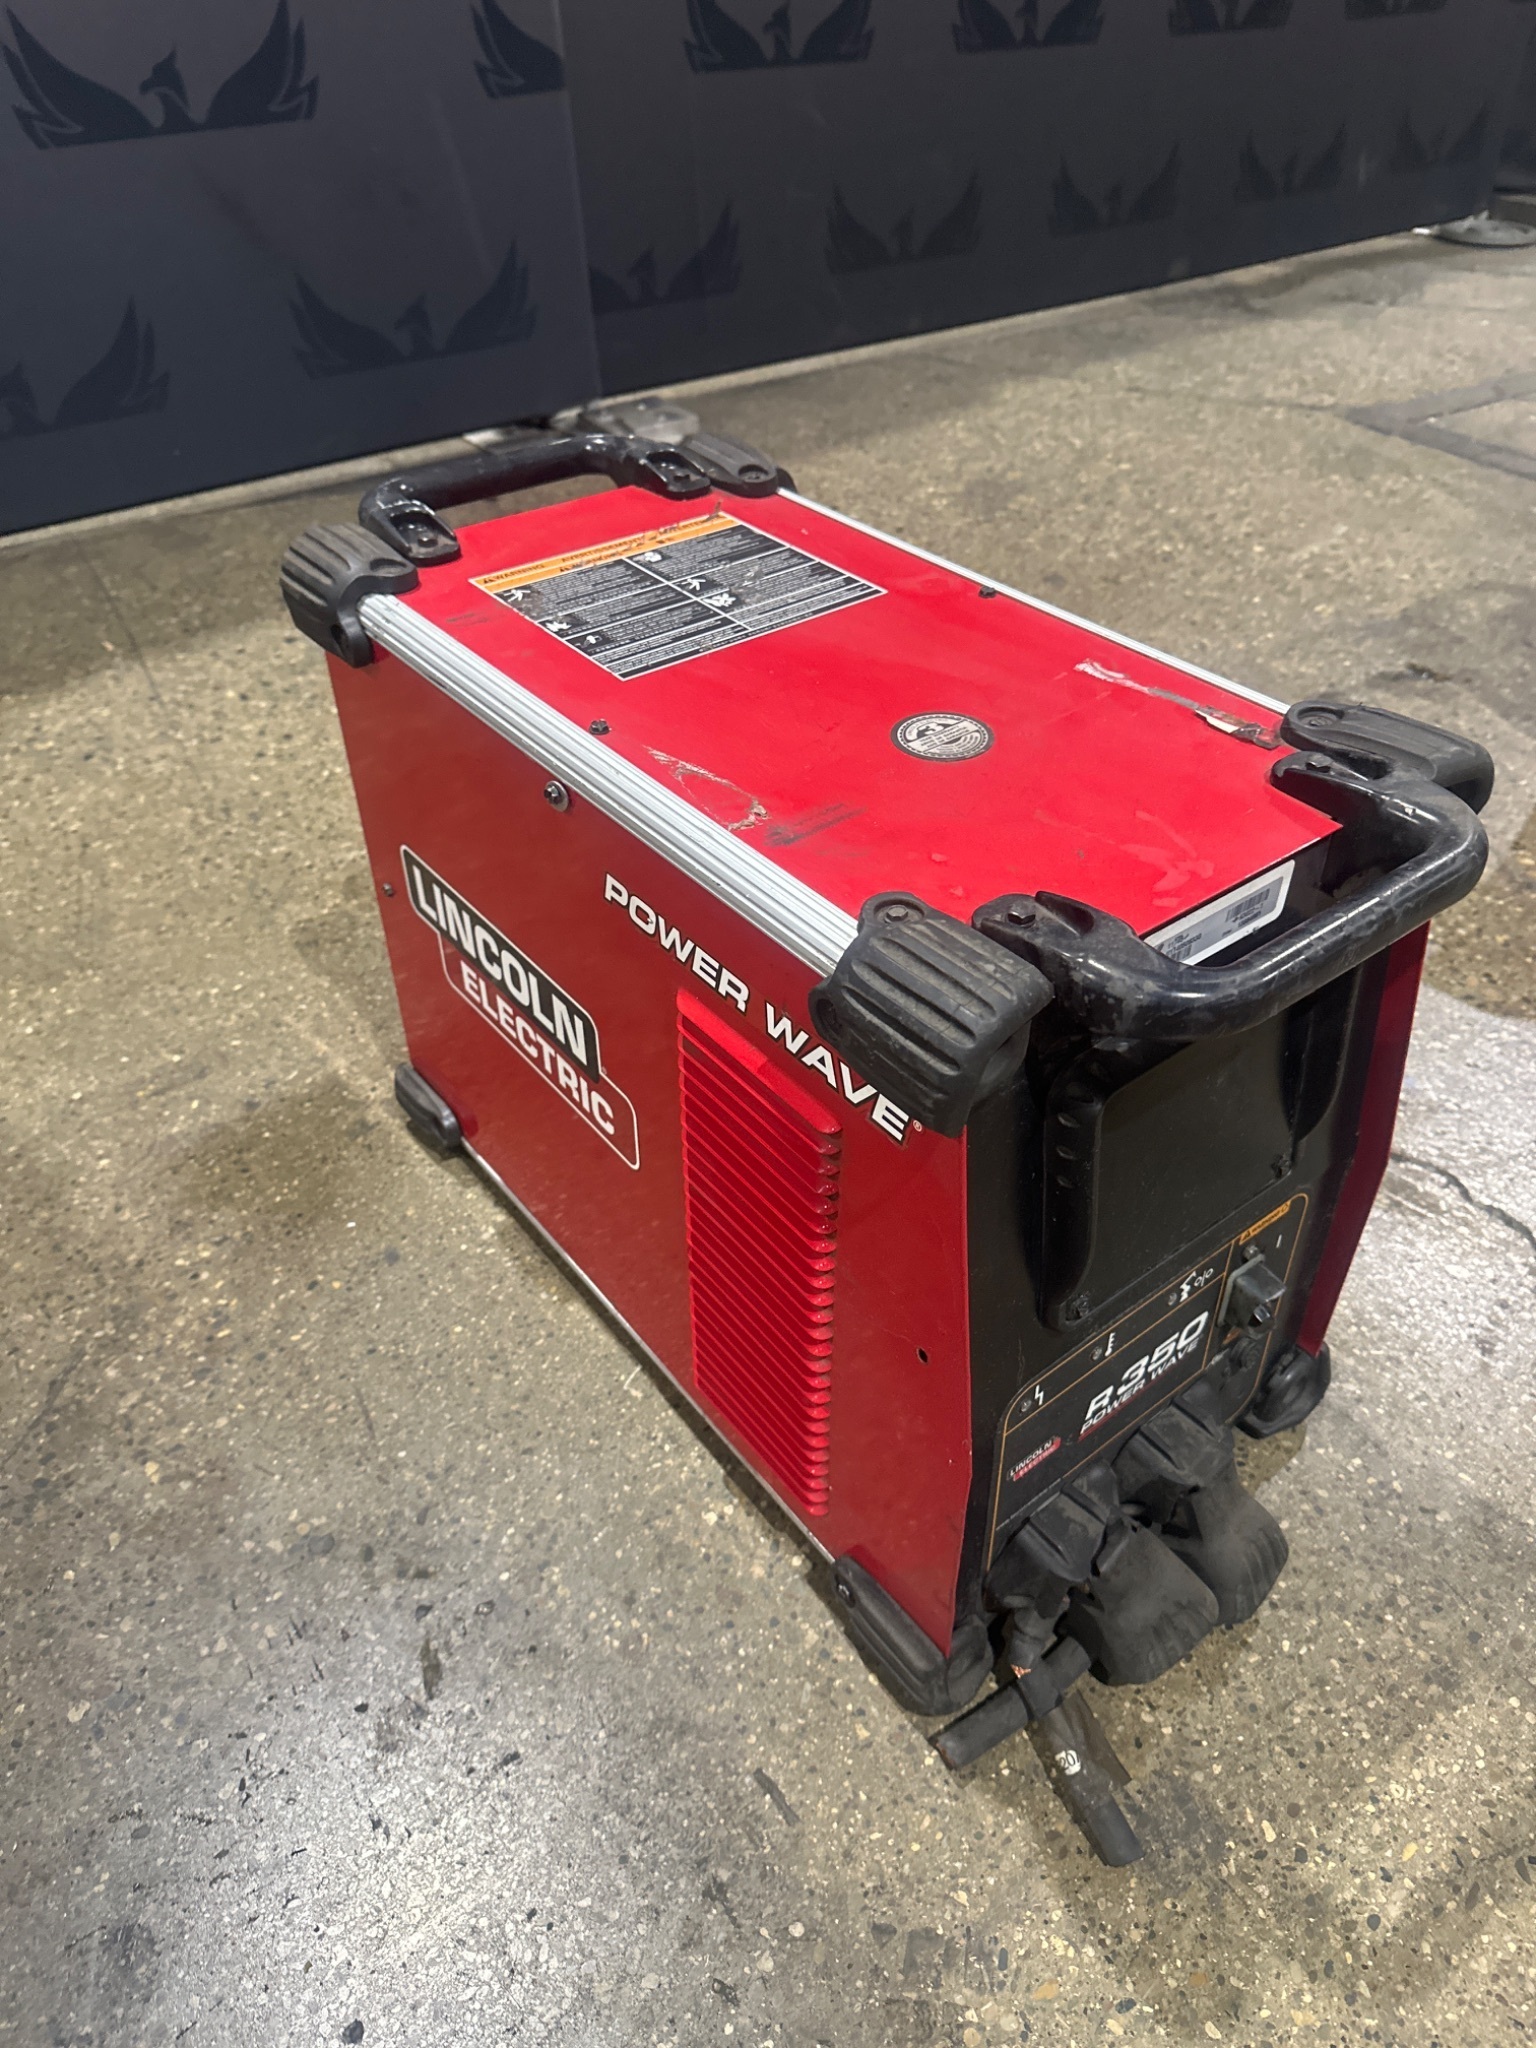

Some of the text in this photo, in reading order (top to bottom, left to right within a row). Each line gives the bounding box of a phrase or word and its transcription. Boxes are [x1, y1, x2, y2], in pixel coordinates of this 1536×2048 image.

[412, 865, 588, 1066] LINCOLN
[604, 873, 749, 1013] POWER
[460, 960, 614, 1135] ELECTRIC
[1080, 1337, 1200, 1435] POWER WAVE
[1085, 1311, 1209, 1421] R350
[1010, 1439, 1052, 1476] LINCOLN
